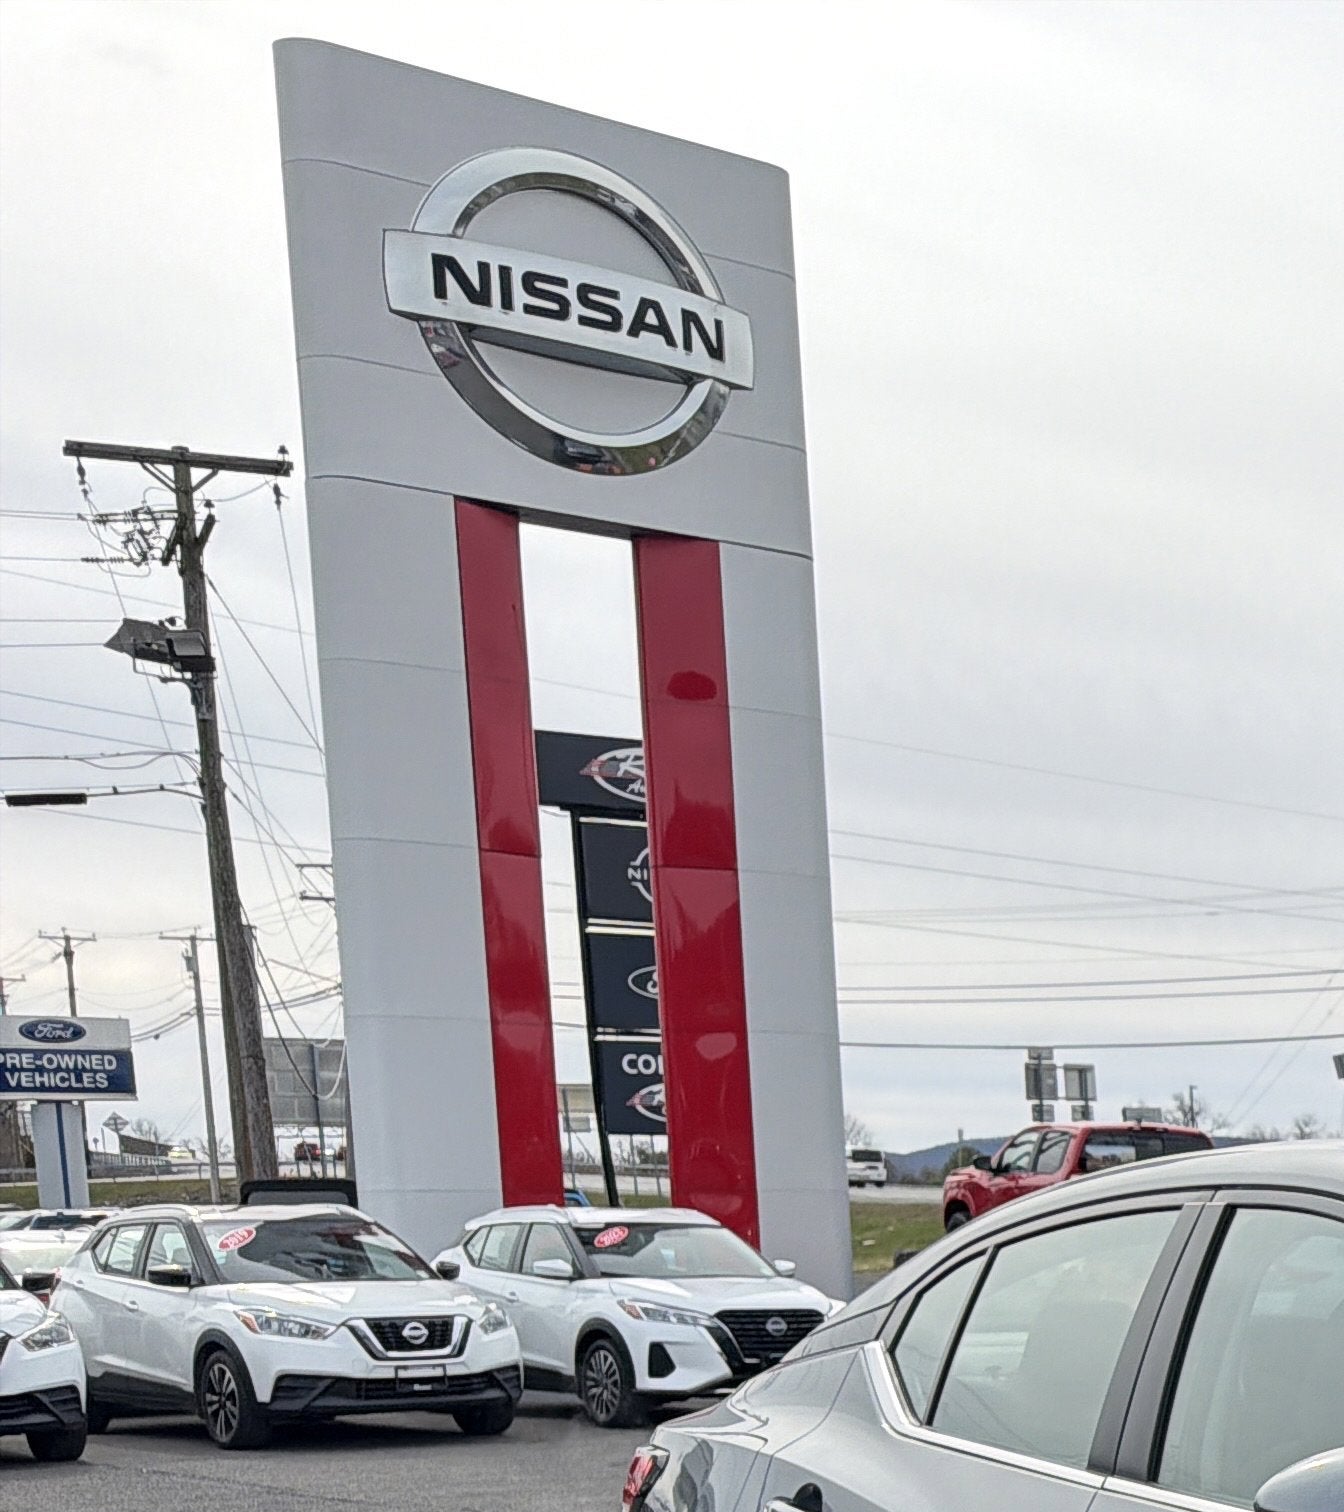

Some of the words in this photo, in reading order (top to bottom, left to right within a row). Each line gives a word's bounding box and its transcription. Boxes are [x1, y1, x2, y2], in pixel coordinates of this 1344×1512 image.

[431, 252, 726, 363] NISSAN
[34, 1022, 74, 1039] Ford
[5, 1071, 109, 1088] VEHICLES
